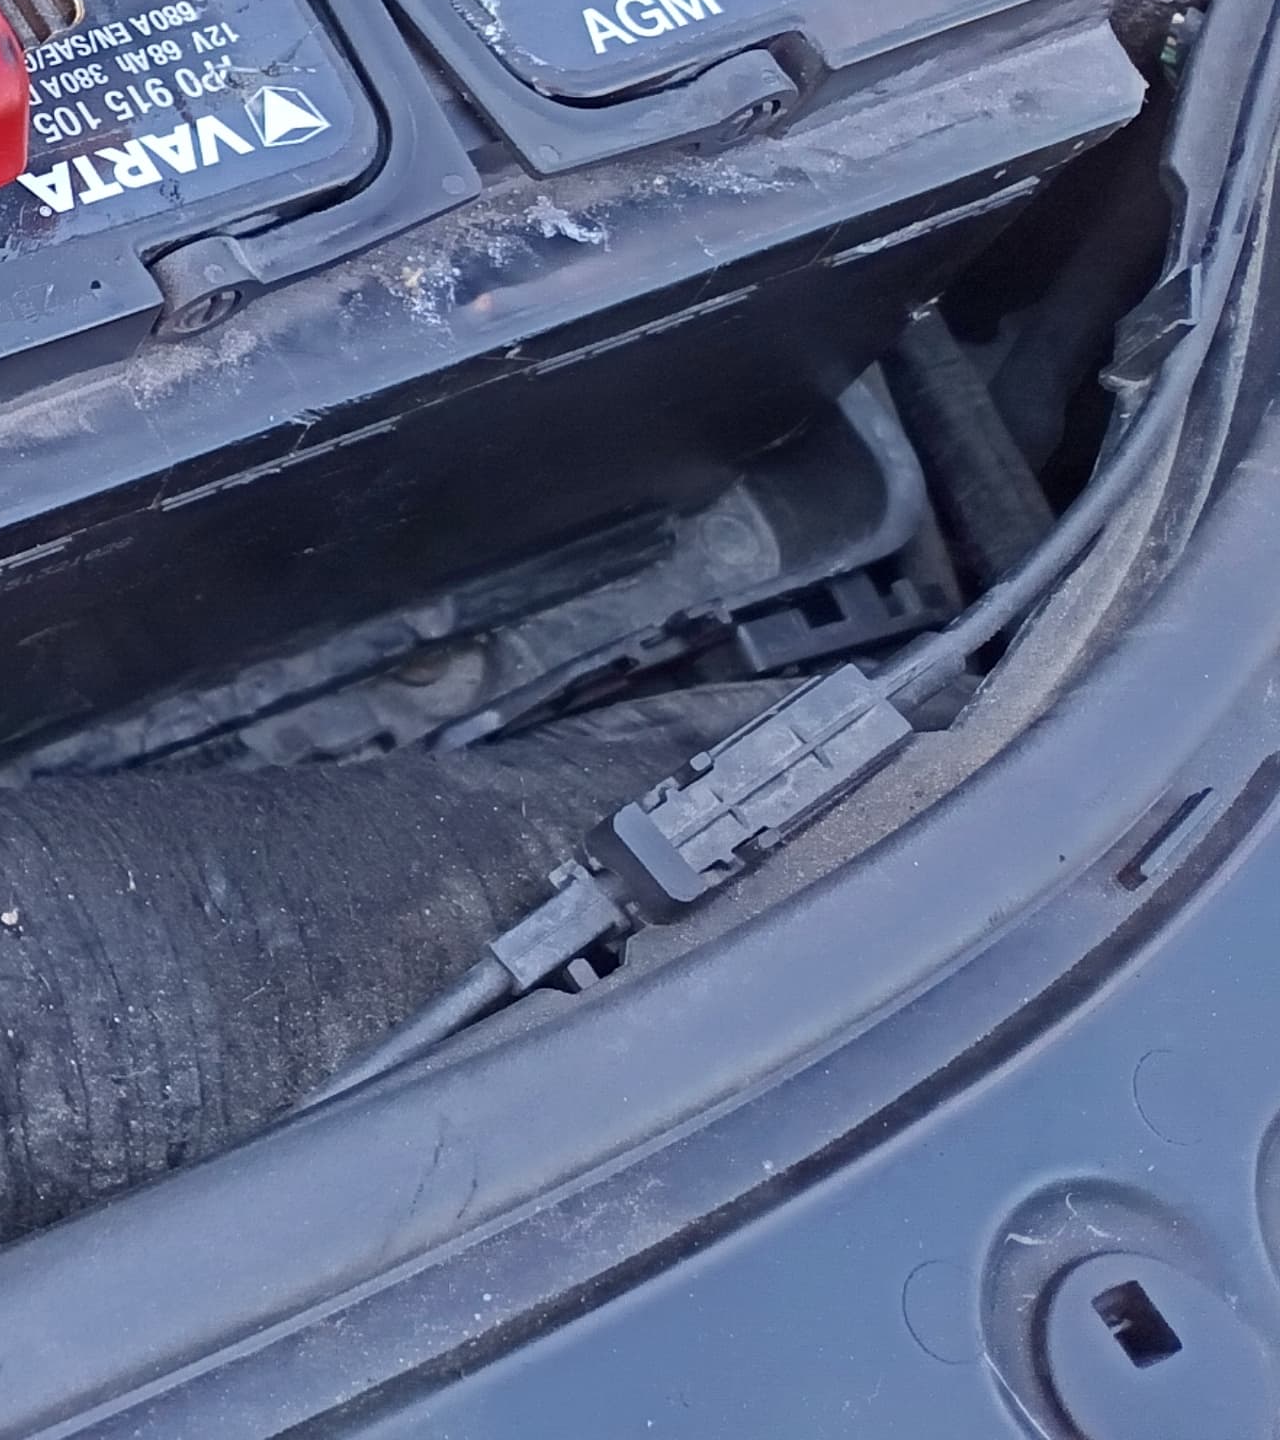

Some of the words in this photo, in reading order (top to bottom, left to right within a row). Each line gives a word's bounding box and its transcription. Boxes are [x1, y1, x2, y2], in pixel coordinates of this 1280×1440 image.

[129, 1, 198, 37] 680A
[191, 21, 240, 54] 12V
[115, 39, 184, 75] 68Ah
[41, 63, 109, 99] 380A
[103, 76, 176, 121] 915
[32, 100, 104, 144] 105
[16, 114, 256, 214] VARTA
